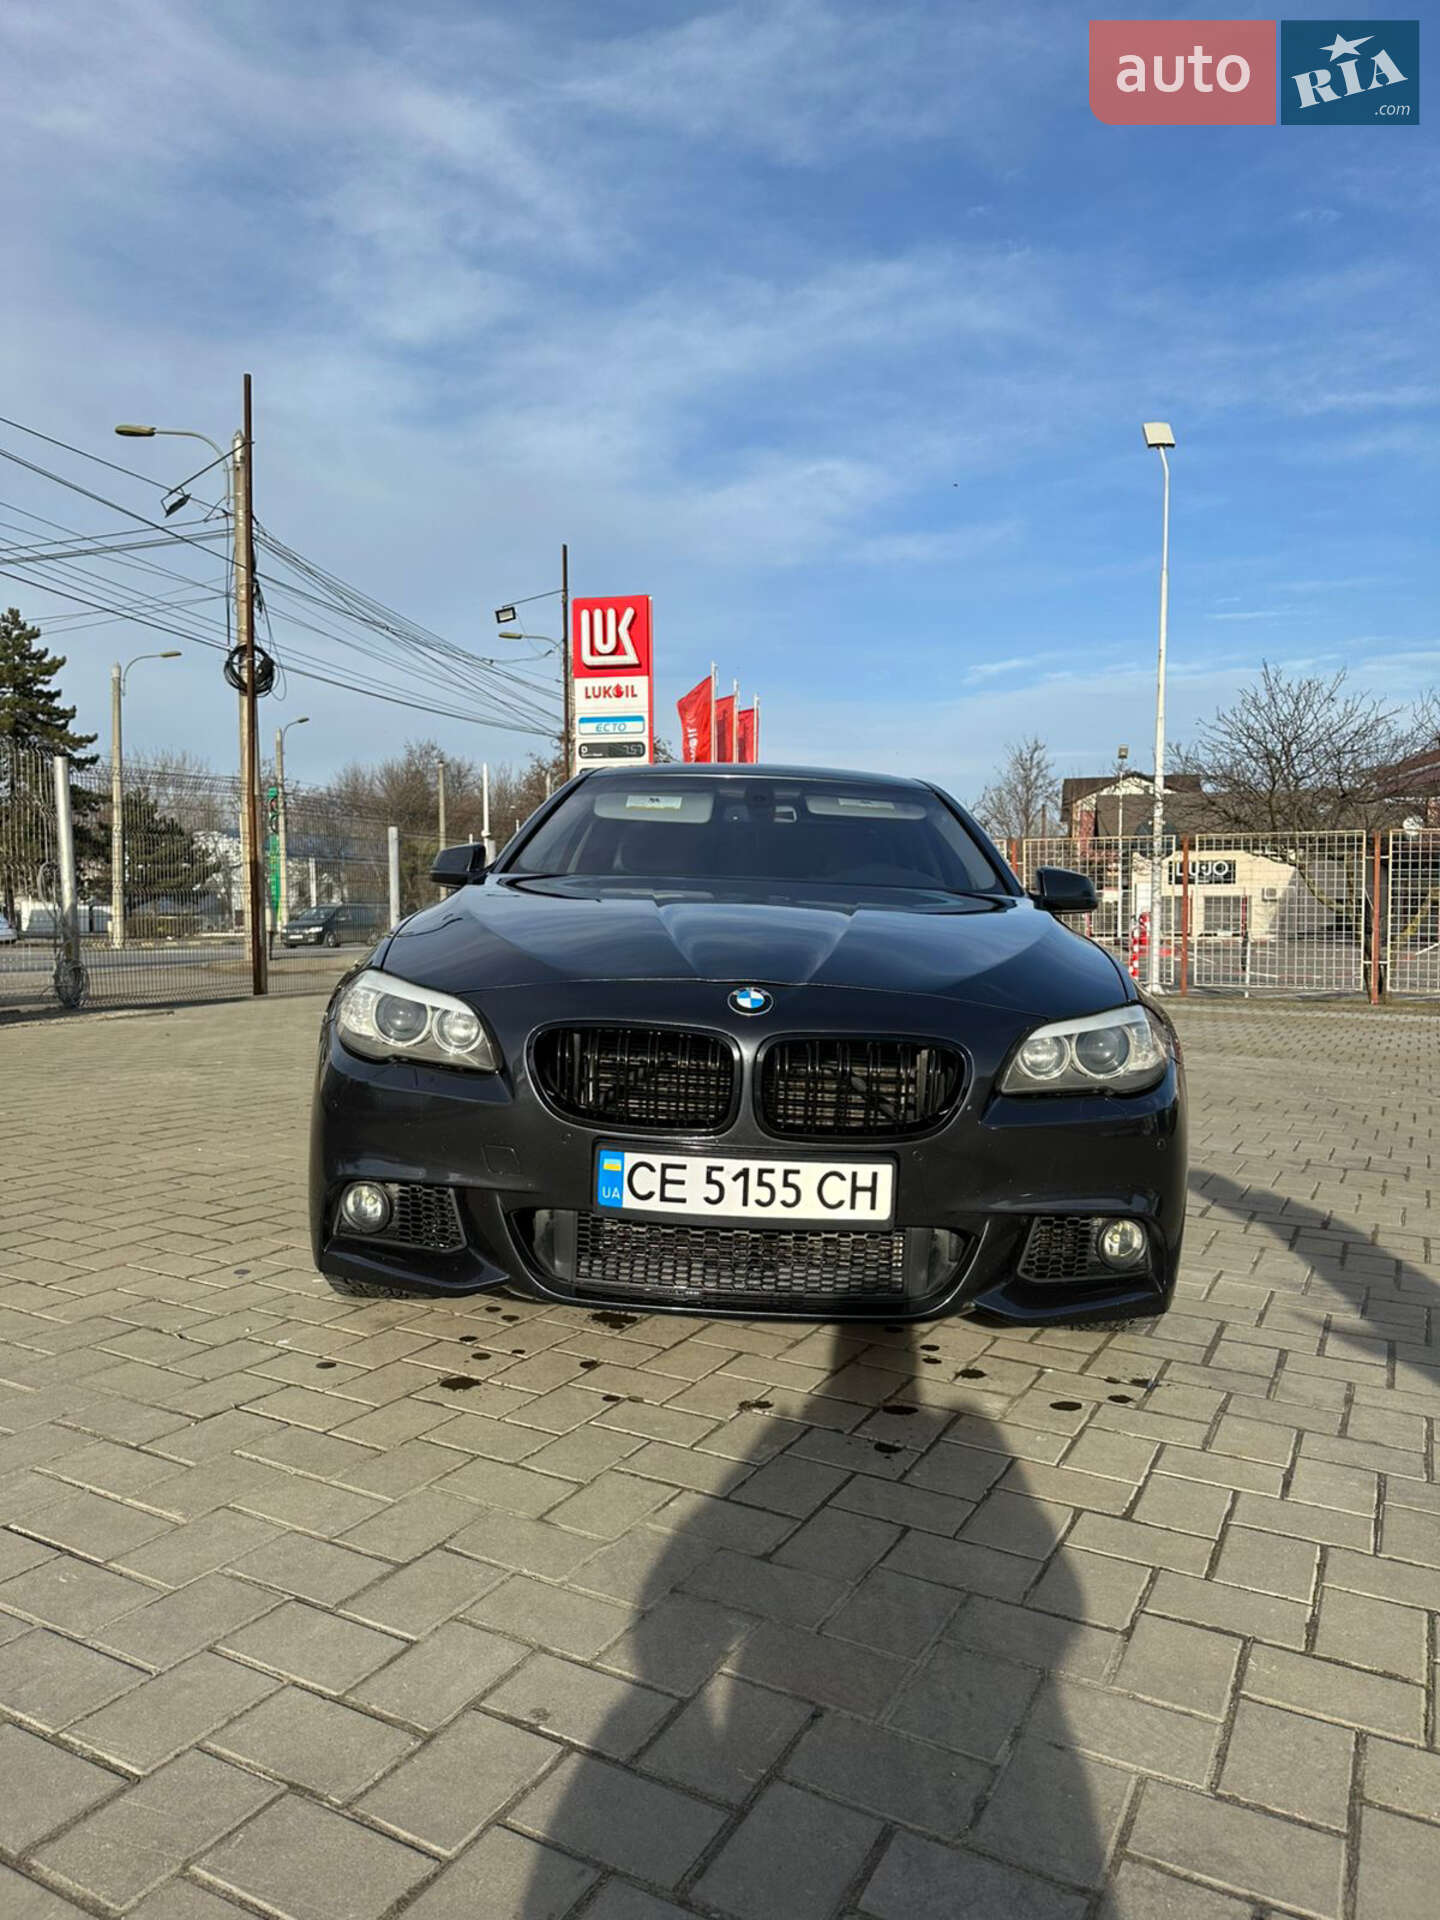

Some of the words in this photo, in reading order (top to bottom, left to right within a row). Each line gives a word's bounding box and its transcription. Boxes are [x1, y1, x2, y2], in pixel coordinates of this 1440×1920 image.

[581, 607, 639, 666] LUK
[584, 684, 638, 699] LUKOIL
[602, 1186, 620, 1199] UA
[627, 1161, 687, 1204] CE
[703, 1165, 801, 1208] 5155
[816, 1171, 878, 1210] CH
